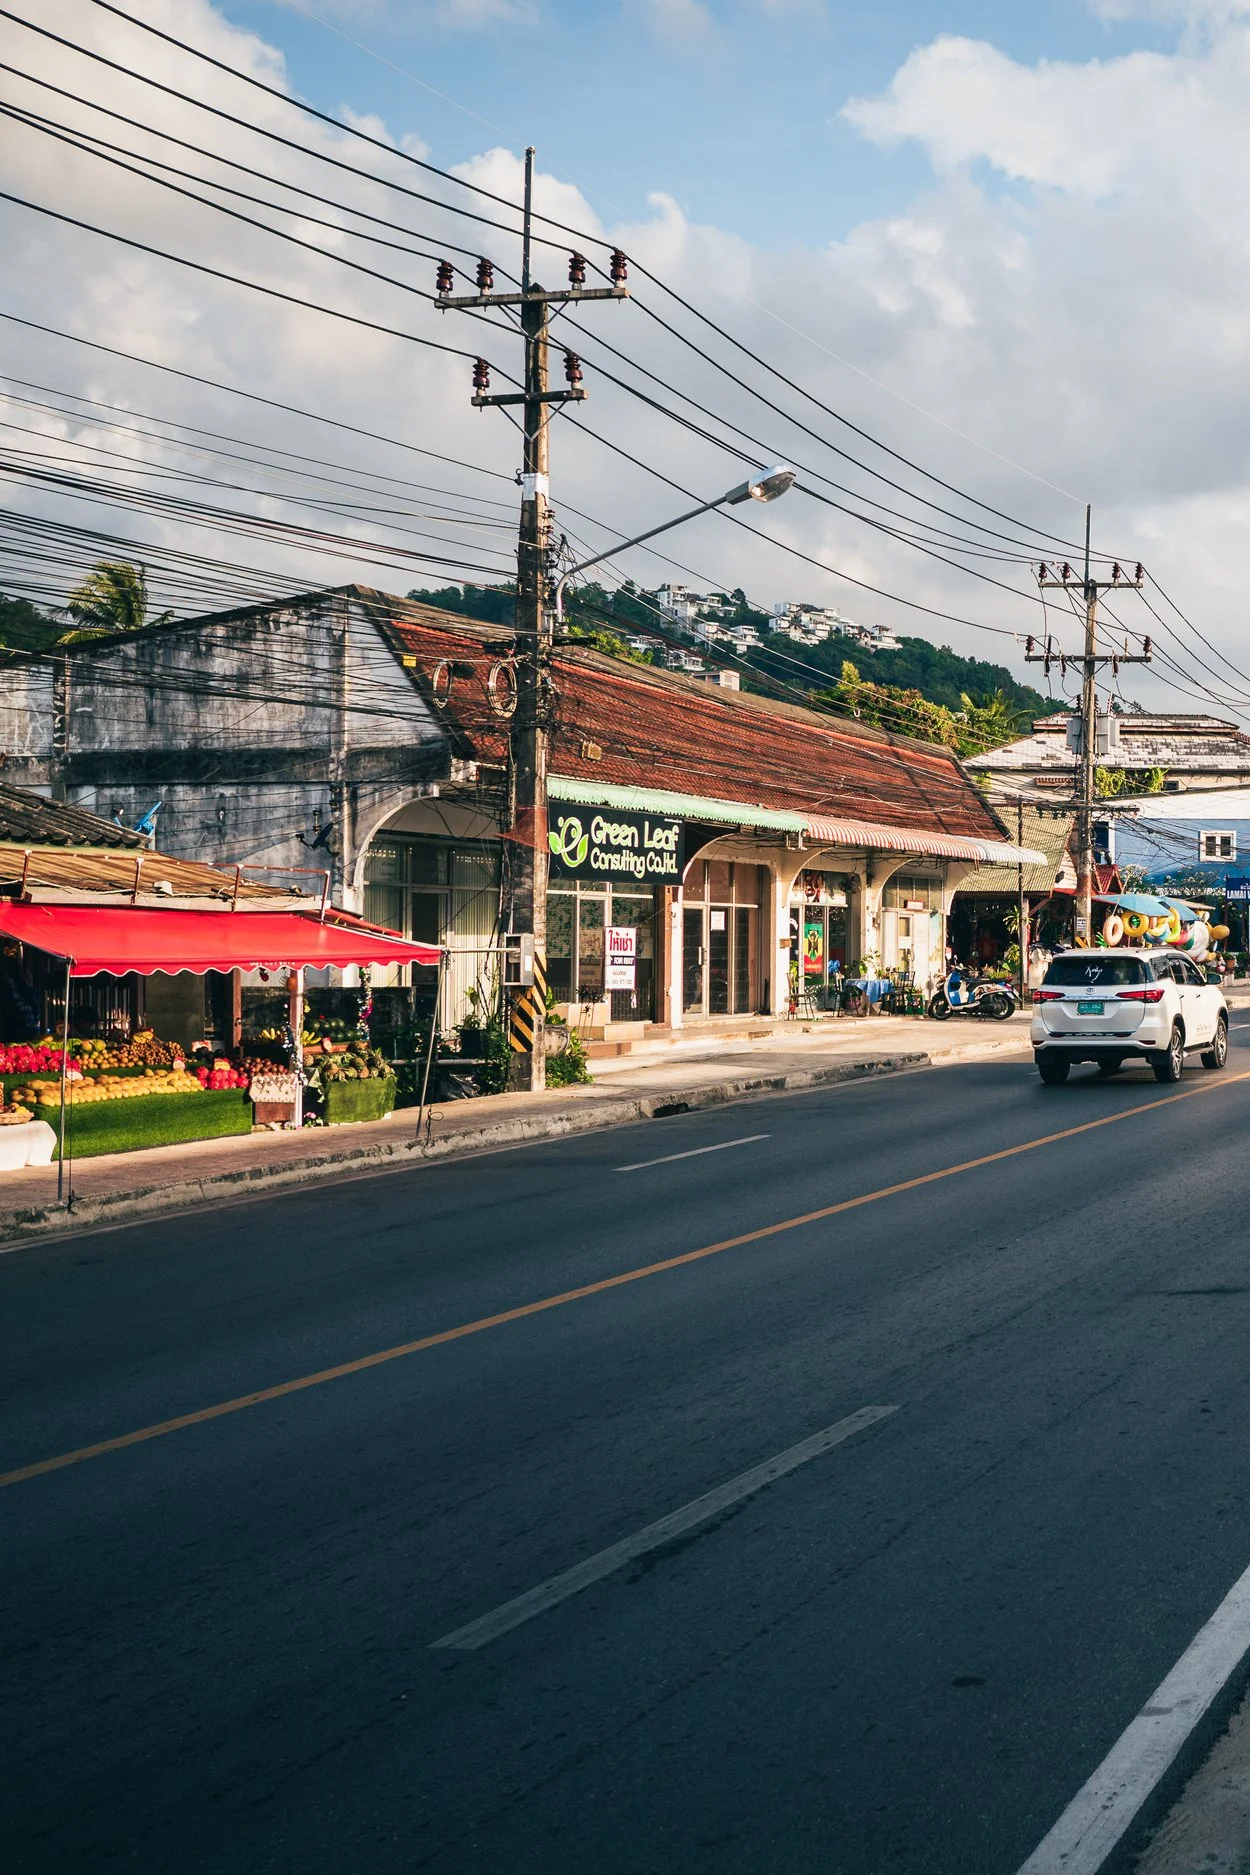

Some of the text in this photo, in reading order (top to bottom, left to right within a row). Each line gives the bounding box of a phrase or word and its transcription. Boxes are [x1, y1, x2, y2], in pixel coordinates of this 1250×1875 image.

[591, 815, 680, 851] Green Leaf
[590, 847, 645, 879] Consulting
[1227, 890, 1247, 899] LAMAI
[608, 929, 634, 952] ให้เช่า
[613, 956, 623, 965] FOR
